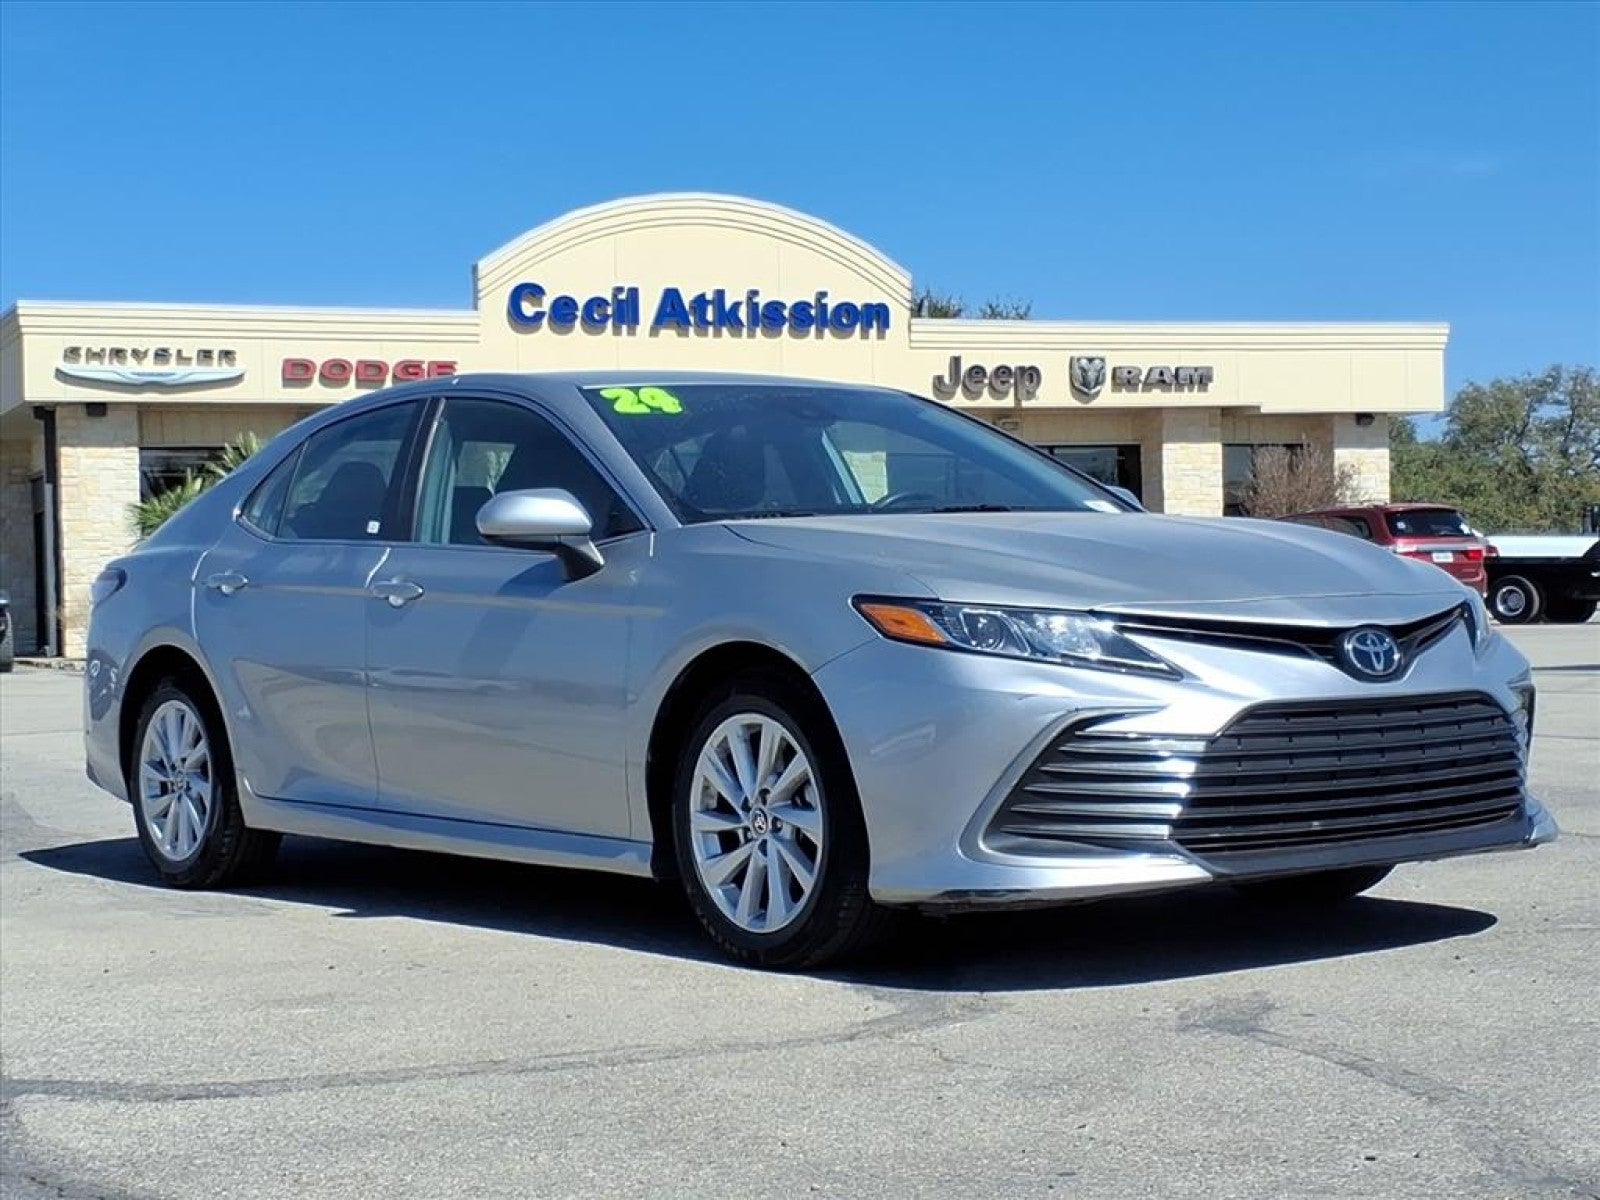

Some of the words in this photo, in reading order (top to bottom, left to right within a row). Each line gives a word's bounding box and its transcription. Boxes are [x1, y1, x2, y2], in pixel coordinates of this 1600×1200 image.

[508, 281, 640, 330] Cecil
[652, 286, 891, 334] Atkission
[63, 346, 237, 367] CHRYSLER
[283, 358, 458, 381] DODGE
[933, 355, 1041, 400] Jeep
[1112, 365, 1214, 391] RAM
